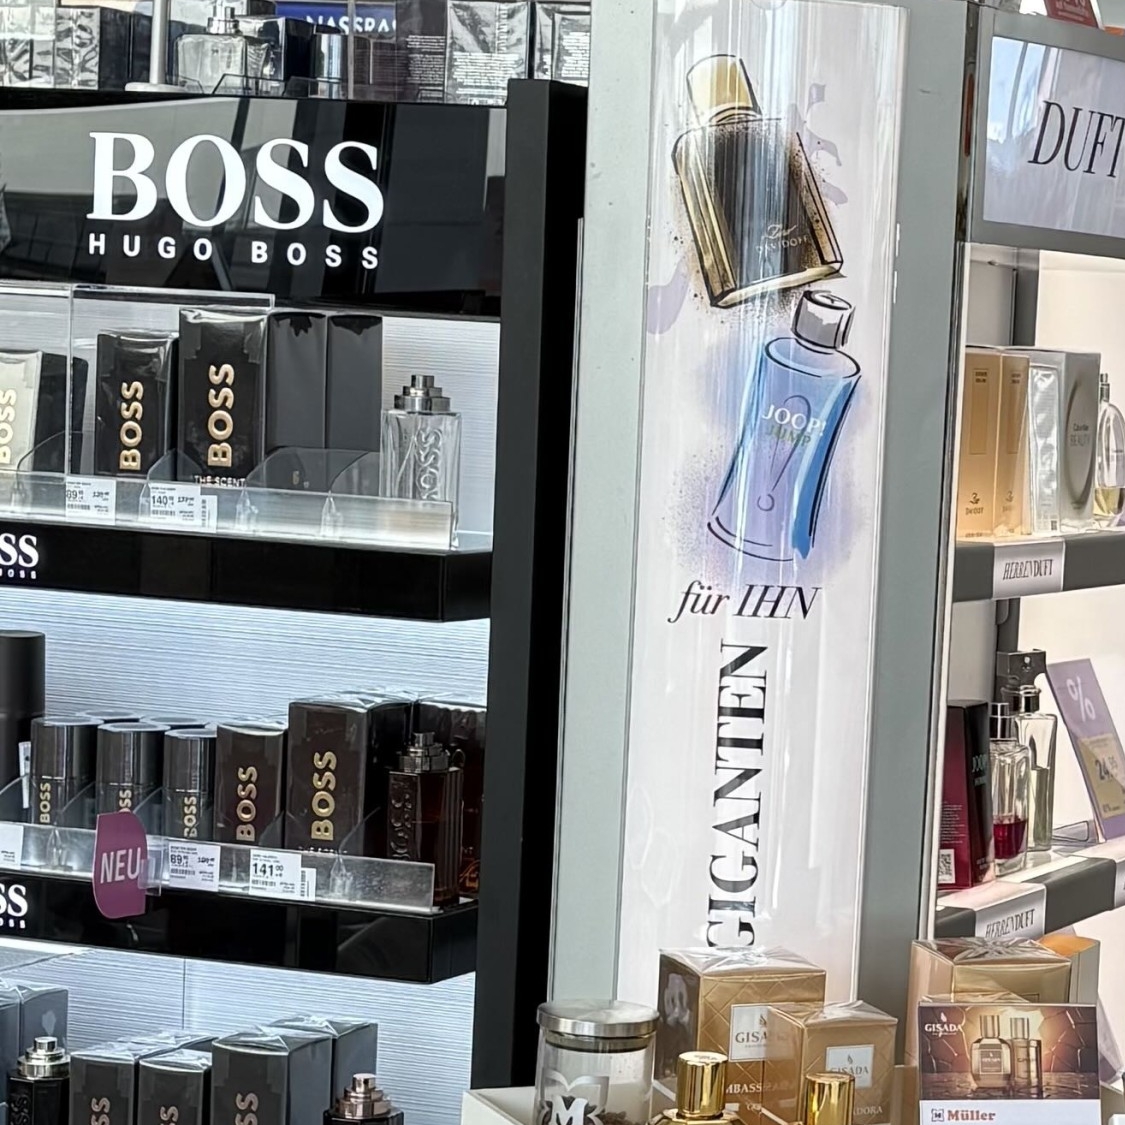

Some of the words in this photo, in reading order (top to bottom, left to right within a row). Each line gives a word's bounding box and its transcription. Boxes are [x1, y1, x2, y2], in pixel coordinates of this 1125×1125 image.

[86, 131, 386, 233] BOSS
[88, 233, 214, 261] HUGO
[250, 239, 380, 269] BOSS
[119, 380, 145, 471] BOSS
[207, 363, 236, 468] BOSS
[762, 404, 827, 437] JOOP!
[667, 579, 730, 624] für
[732, 584, 823, 620] IHN
[39, 782, 51, 824] BOSS
[236, 765, 259, 842] BOSS
[310, 750, 338, 841] BOSS
[706, 638, 768, 949] GIGANTEN
[183, 795, 198, 838] BOSS
[100, 846, 141, 884] NEU
[924, 1023, 962, 1033] GISADA
[947, 1110, 996, 1121] Müller
